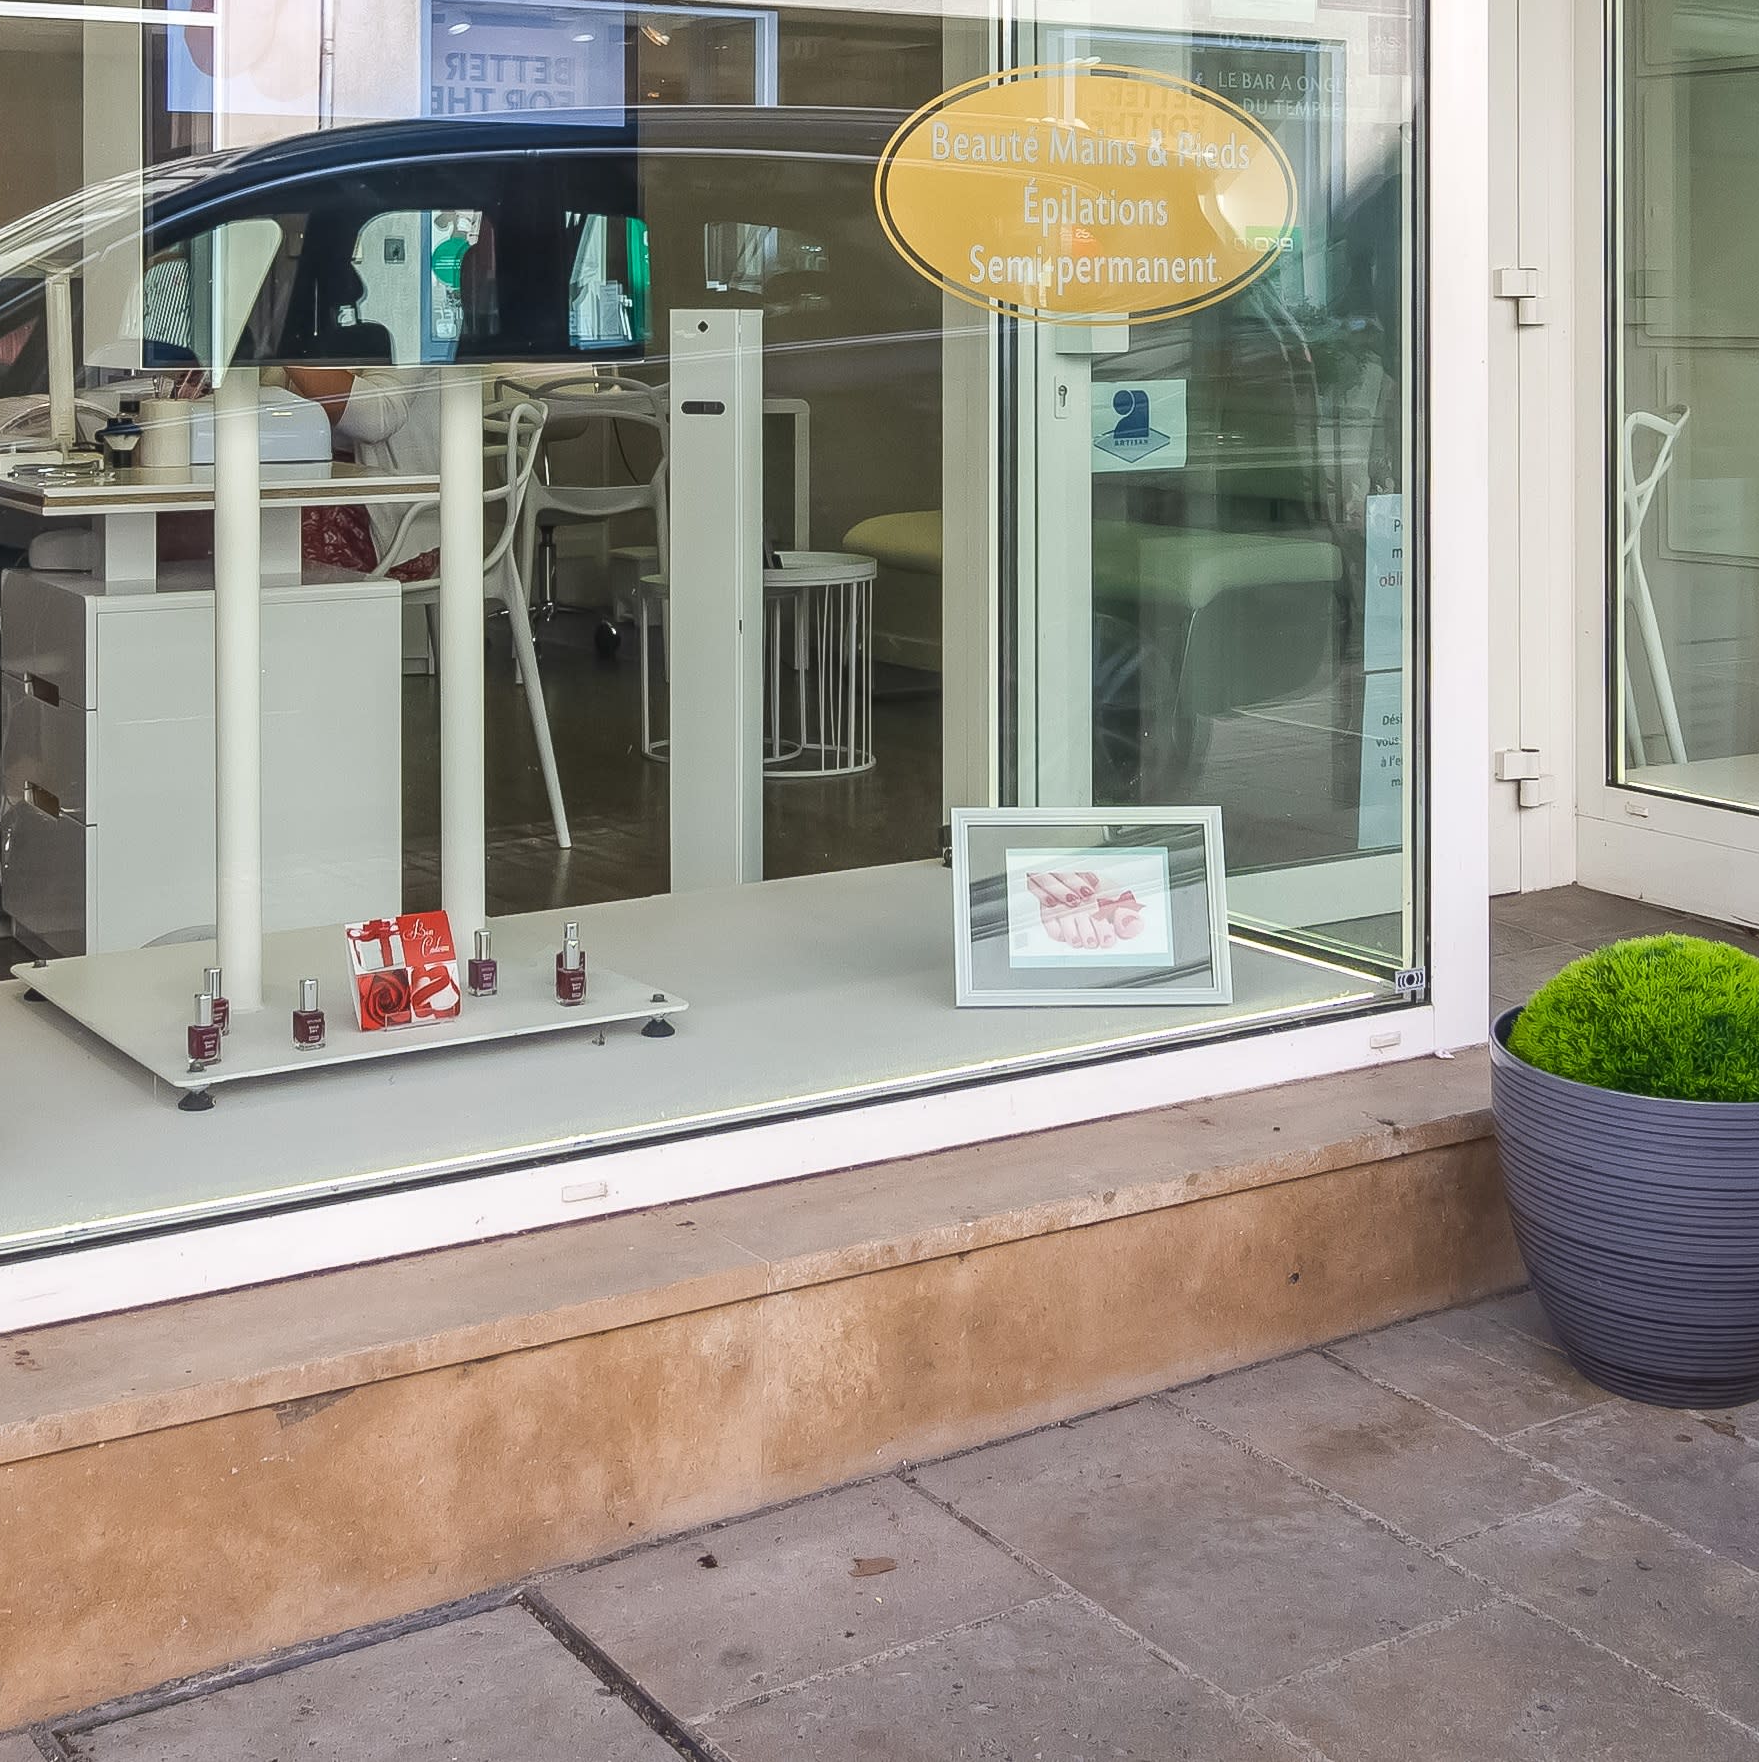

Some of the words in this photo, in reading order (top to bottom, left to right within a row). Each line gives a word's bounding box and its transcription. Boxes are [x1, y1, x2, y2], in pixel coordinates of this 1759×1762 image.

[1218, 71, 1238, 89] LE
[1242, 72, 1275, 90] BAR
[1281, 75, 1292, 90] A
[930, 121, 1040, 162] Beauté
[1048, 127, 1137, 167] Mains
[1146, 128, 1168, 167] &
[1177, 130, 1250, 170] Pieds
[1023, 177, 1169, 237] Épilations
[1393, 519, 1403, 532] P
[1375, 736, 1400, 747] vous
[1389, 754, 1403, 767] l'e
